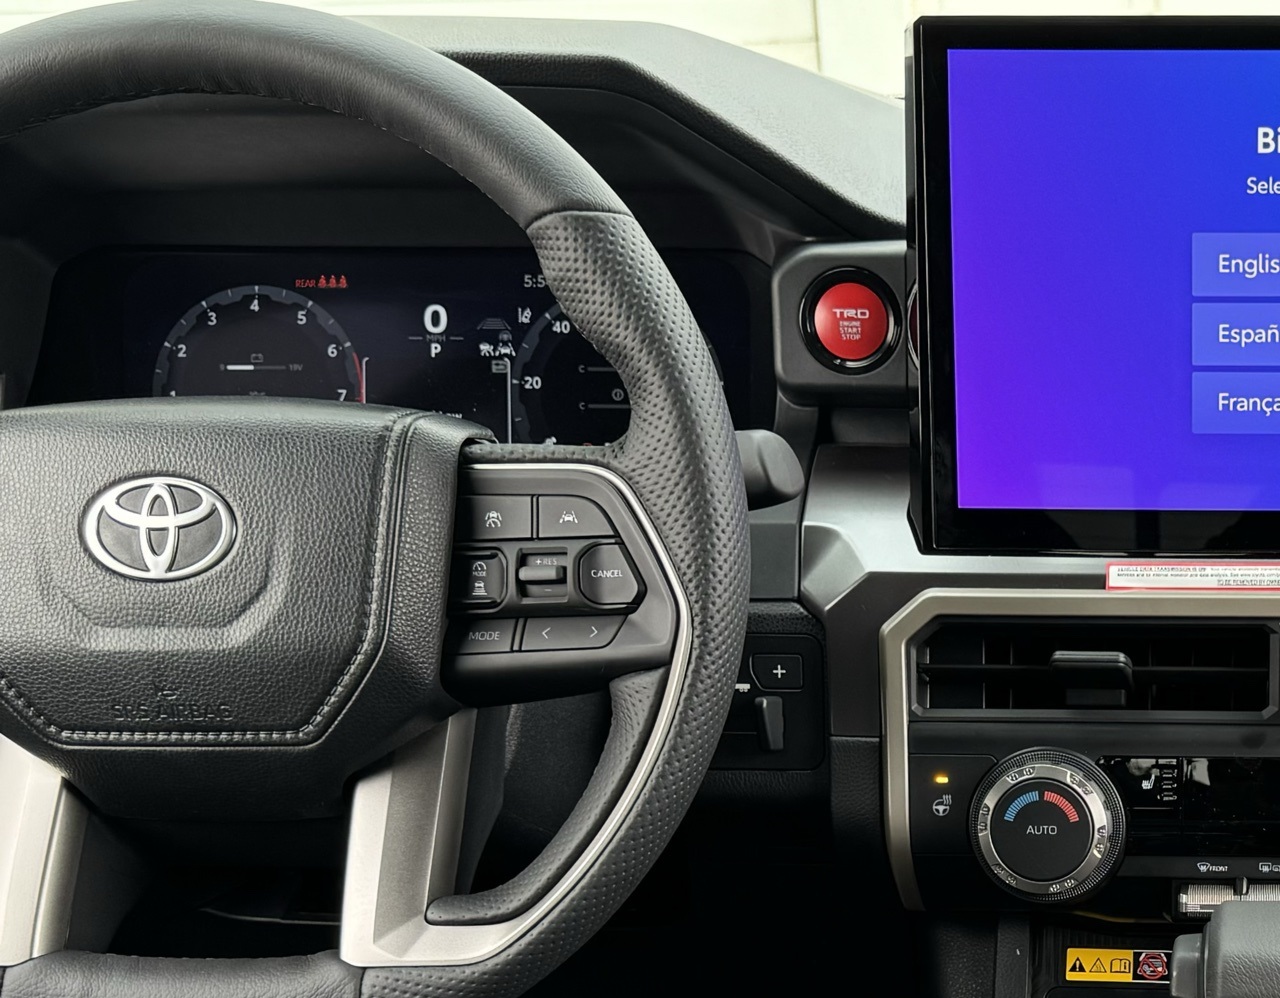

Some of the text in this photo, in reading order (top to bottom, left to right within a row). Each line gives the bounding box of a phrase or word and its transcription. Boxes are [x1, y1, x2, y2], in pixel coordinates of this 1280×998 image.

[295, 279, 316, 288] REAR
[523, 274, 549, 288] 5:5
[250, 299, 260, 312] 4
[207, 311, 217, 325] 3
[297, 311, 307, 325] 5
[423, 304, 448, 334] 0
[832, 308, 870, 319] TRD
[552, 320, 571, 334] 40
[177, 344, 187, 357] 2
[327, 344, 338, 357] 6
[430, 343, 442, 358] P
[523, 376, 542, 389] 20
[337, 389, 347, 402] 7
[590, 569, 624, 578] CANCEL
[468, 631, 500, 641] MODE
[1026, 825, 1058, 835] AUTO
